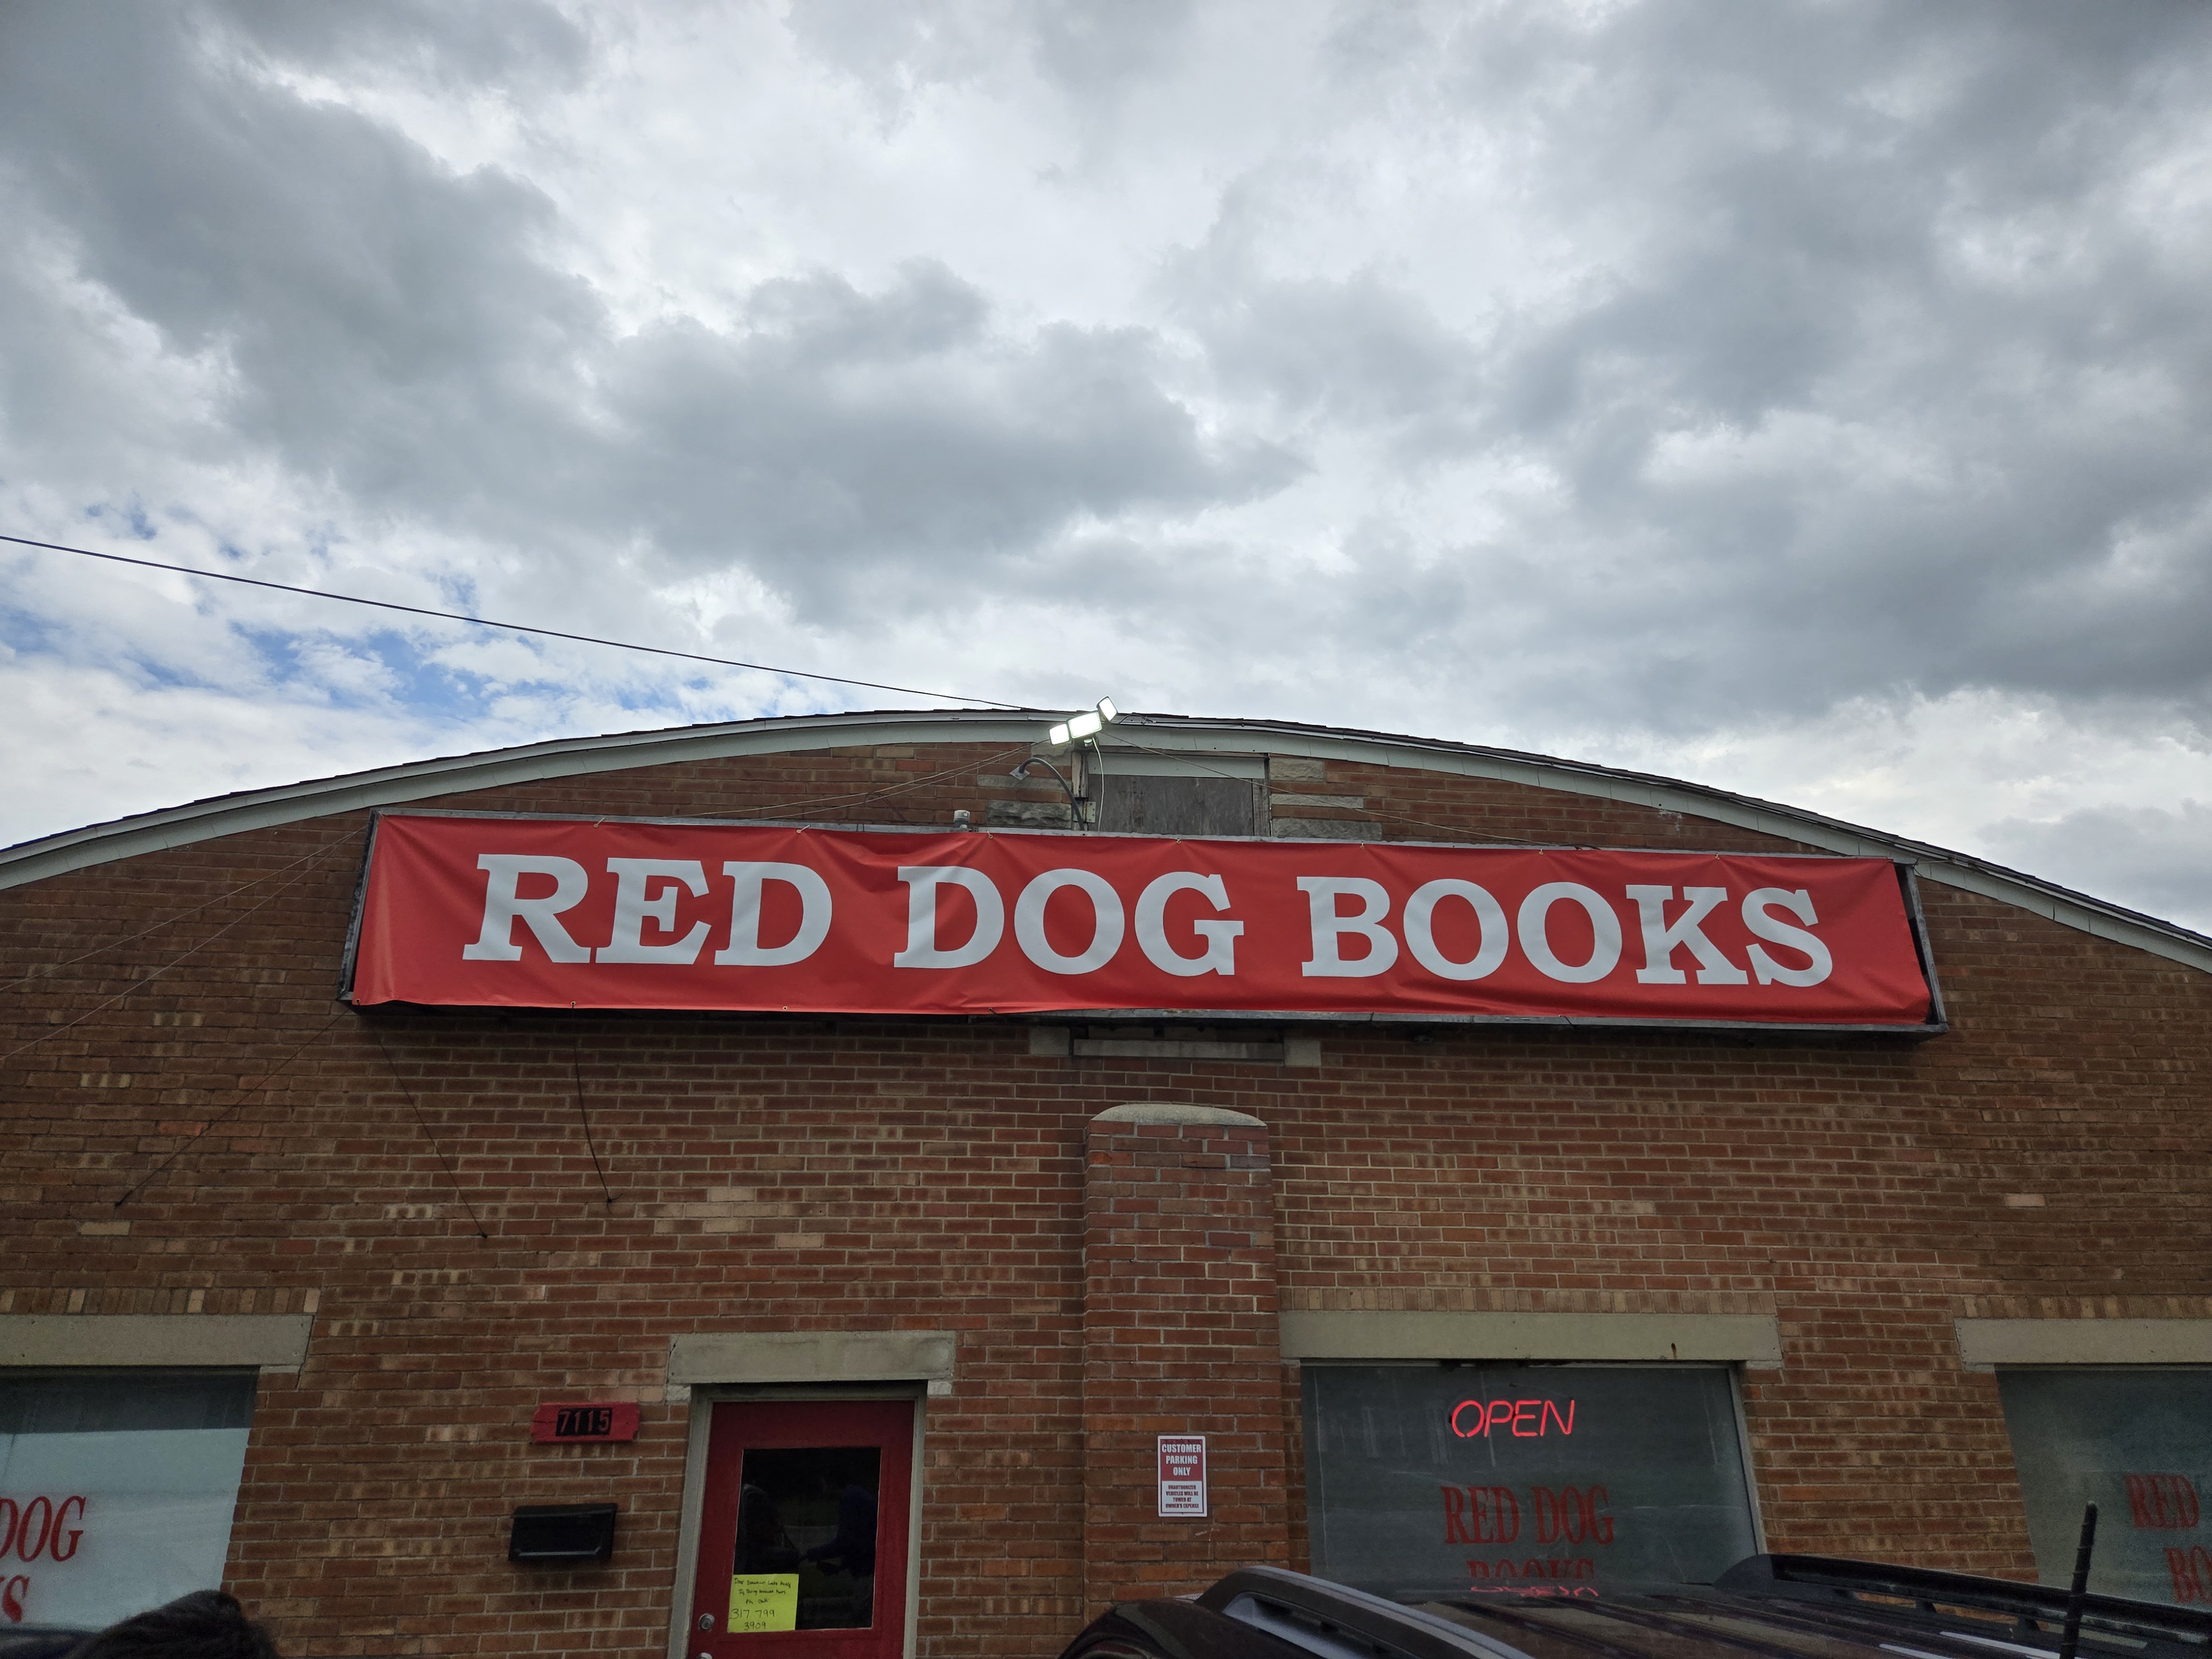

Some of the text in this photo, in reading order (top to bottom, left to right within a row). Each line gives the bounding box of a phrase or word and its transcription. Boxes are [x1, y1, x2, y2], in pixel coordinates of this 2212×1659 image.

[463, 854, 1833, 987] RED DOG BOOKS
[559, 1411, 609, 1433] 7115
[1452, 1399, 1575, 1437] OPEN
[1161, 1444, 1202, 1453] CUSTOMER
[1166, 1455, 1198, 1464] PARKING
[1173, 1467, 1191, 1476] ONLY
[2124, 1474, 2199, 1528] RED
[1441, 1485, 1614, 1545] RED DOG
[755, 1609, 775, 1618] 799
[744, 1621, 766, 1631] 3909
